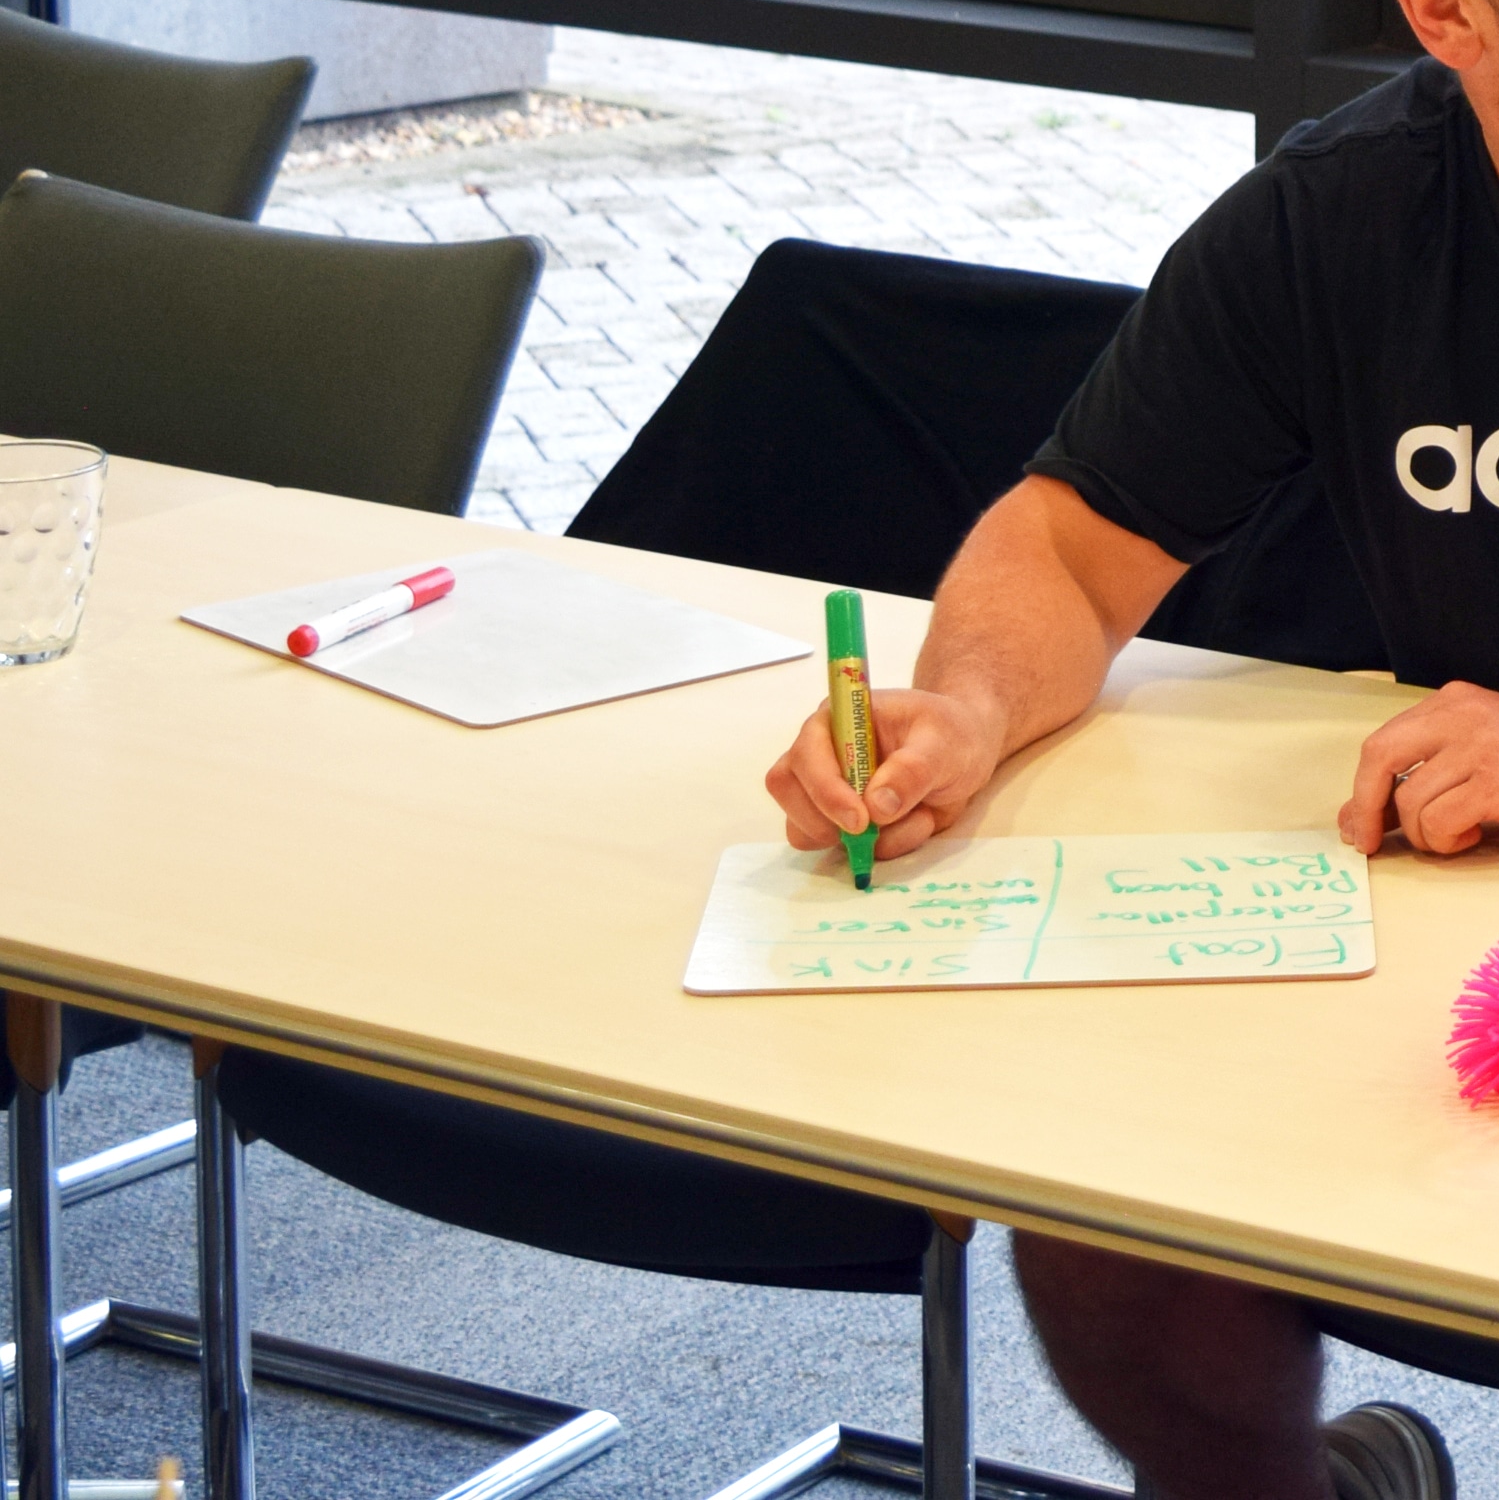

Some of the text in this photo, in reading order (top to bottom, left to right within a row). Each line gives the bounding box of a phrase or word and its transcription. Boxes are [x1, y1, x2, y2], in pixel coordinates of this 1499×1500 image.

[851, 689, 867, 730] MARKER
[1181, 852, 1331, 877] Ball
[1086, 899, 1353, 925] Caterpillar
[1155, 933, 1344, 968] Float
